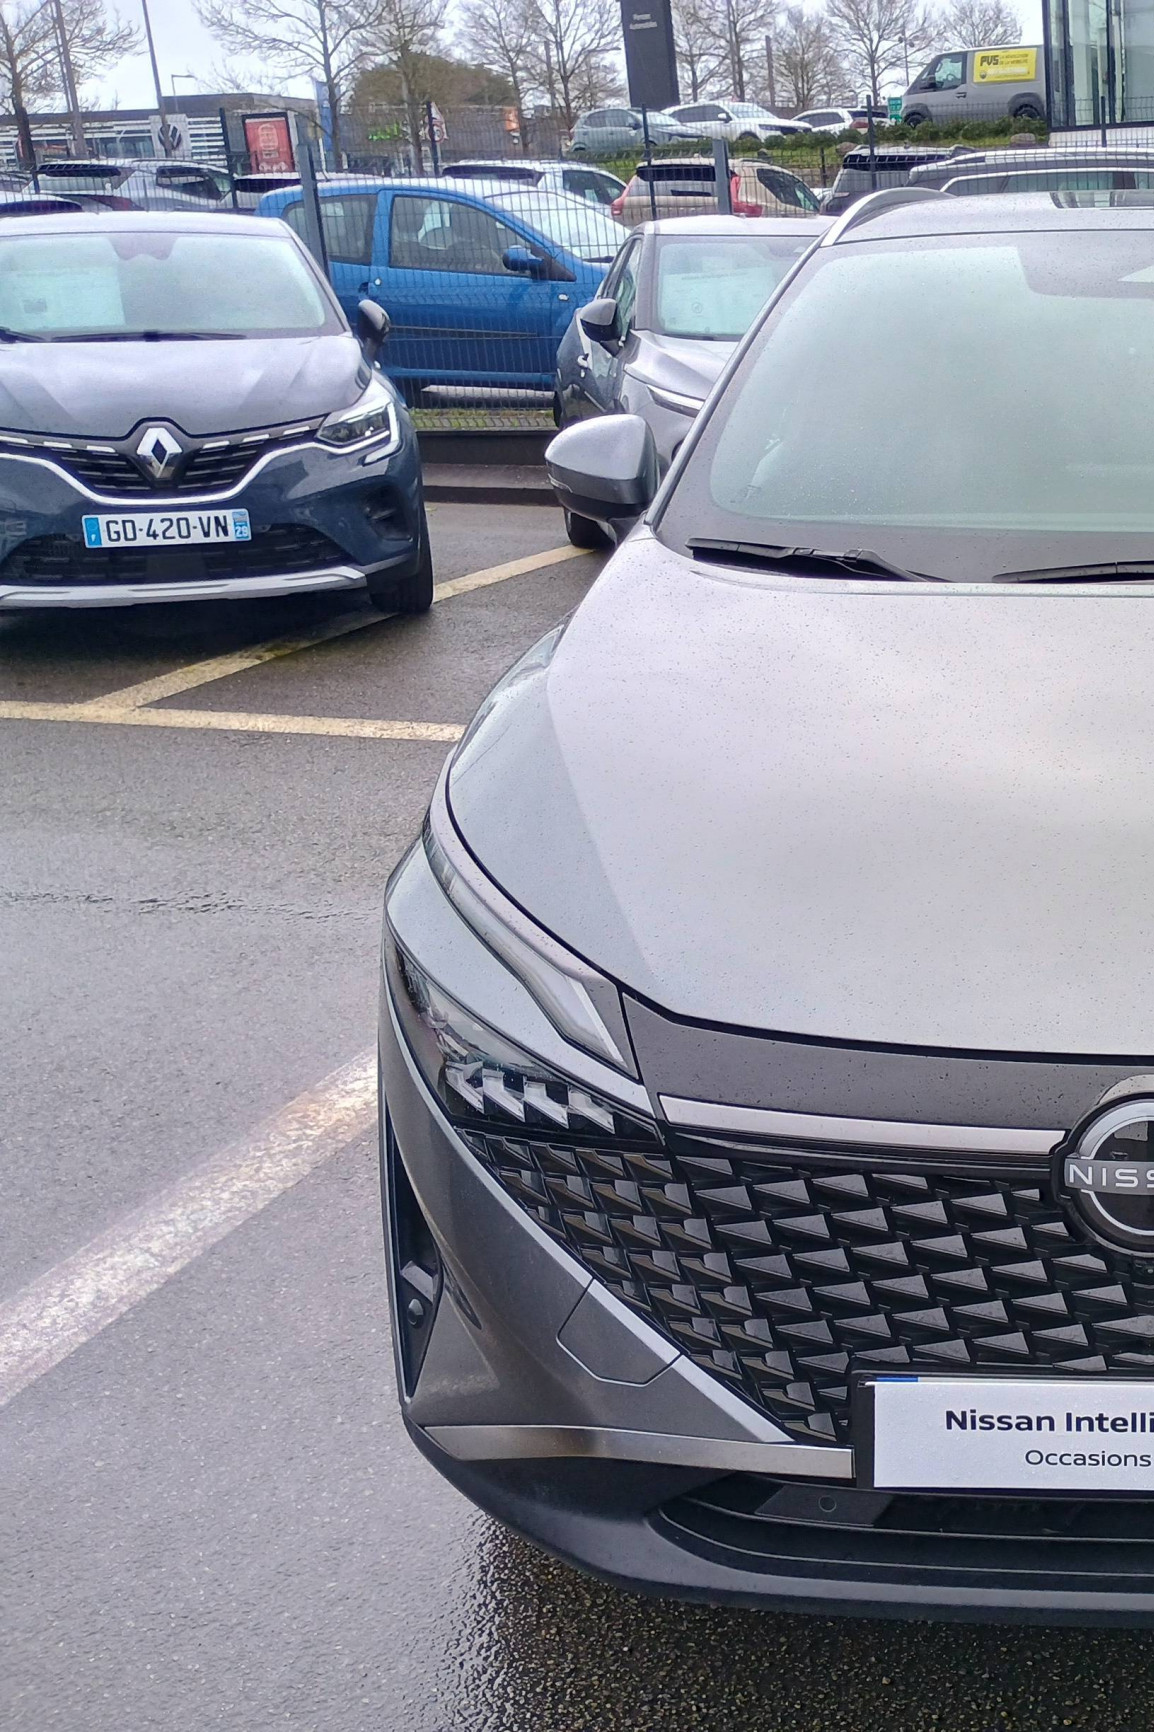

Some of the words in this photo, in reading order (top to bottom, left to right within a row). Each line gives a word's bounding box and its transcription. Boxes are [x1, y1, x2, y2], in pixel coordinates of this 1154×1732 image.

[105, 515, 230, 542] GD-420-VN
[945, 1409, 1055, 1432] Nissan
[1024, 1449, 1152, 1467] Occasions
